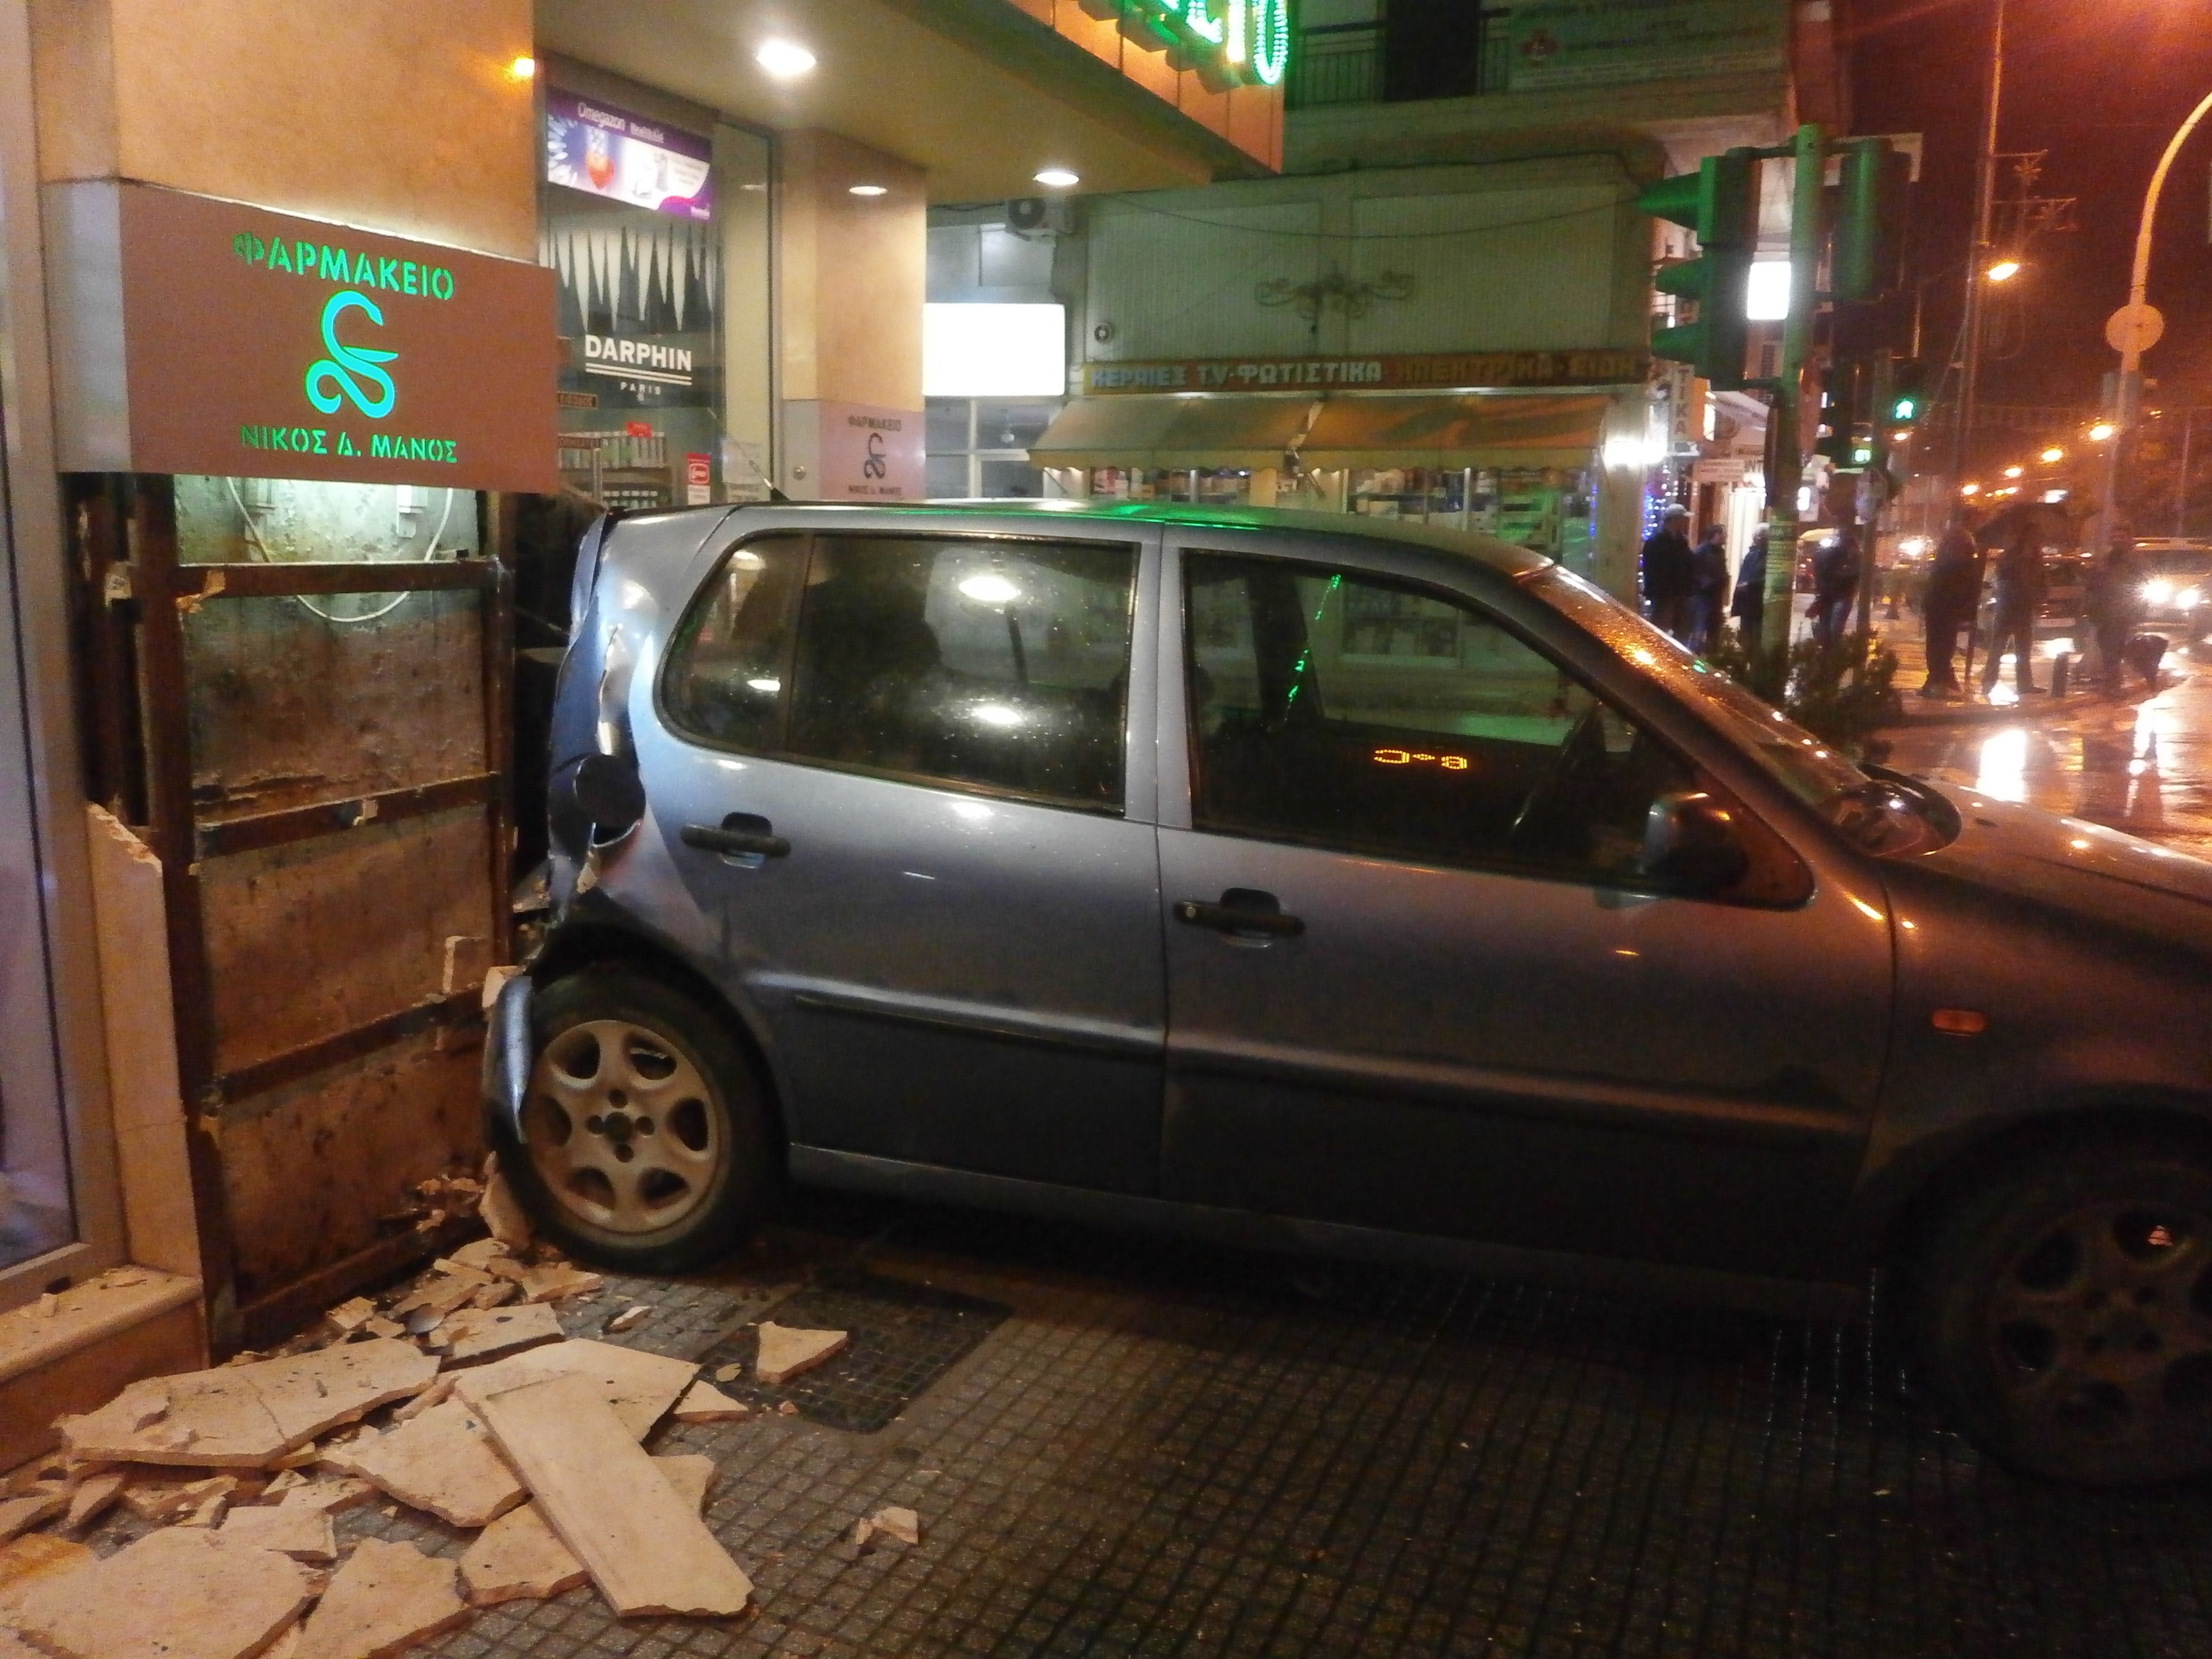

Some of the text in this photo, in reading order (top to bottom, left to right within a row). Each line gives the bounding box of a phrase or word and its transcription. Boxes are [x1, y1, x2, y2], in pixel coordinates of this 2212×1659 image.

[233, 232, 454, 301] ΦΑΡΜΑΚΕΙΟ
[585, 334, 692, 372] DARPHIN
[620, 381, 661, 396] PARIS
[241, 425, 458, 463] ΝΙΚΟΣ Δ. ΜΑΝΟΣ
